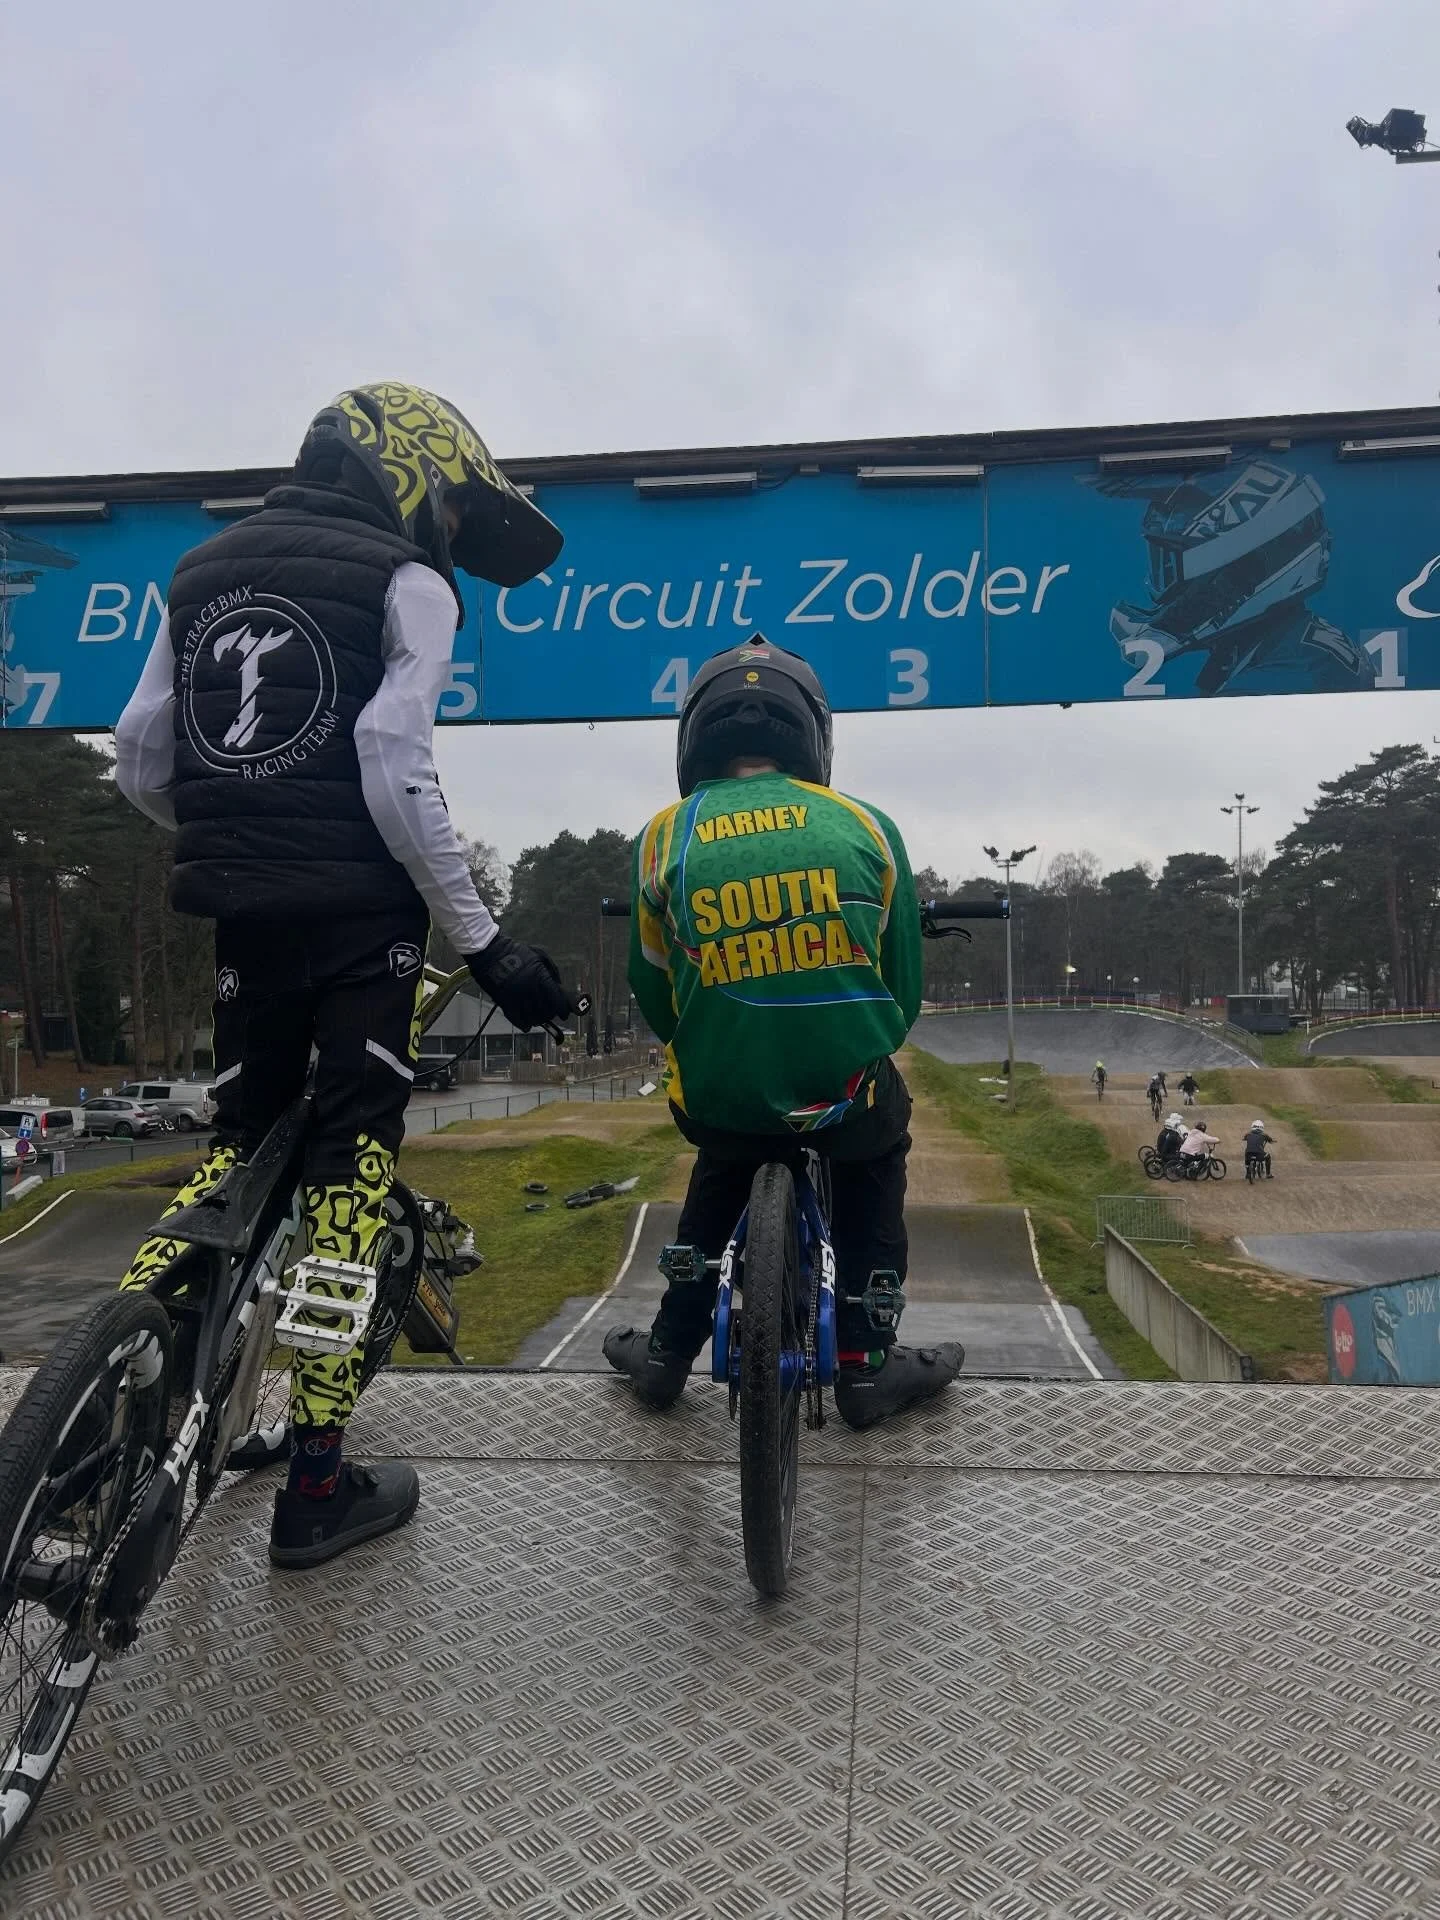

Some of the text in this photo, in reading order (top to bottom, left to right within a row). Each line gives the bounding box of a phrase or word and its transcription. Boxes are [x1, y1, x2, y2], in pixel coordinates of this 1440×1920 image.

[219, 584, 253, 610] BMX
[496, 562, 763, 633] Circuit
[784, 550, 1070, 624] Zolder
[651, 657, 689, 713] 4
[888, 648, 930, 706] 3
[1123, 639, 1166, 697] 2
[1363, 630, 1406, 688] 1
[23, 672, 61, 725] 7
[440, 662, 478, 718] 5
[241, 709, 340, 780] RACING TEAM
[695, 805, 809, 844] VARNEY
[691, 867, 841, 935] SOUTH
[699, 919, 855, 988] AFRICA
[1406, 1285, 1435, 1317] BMX
